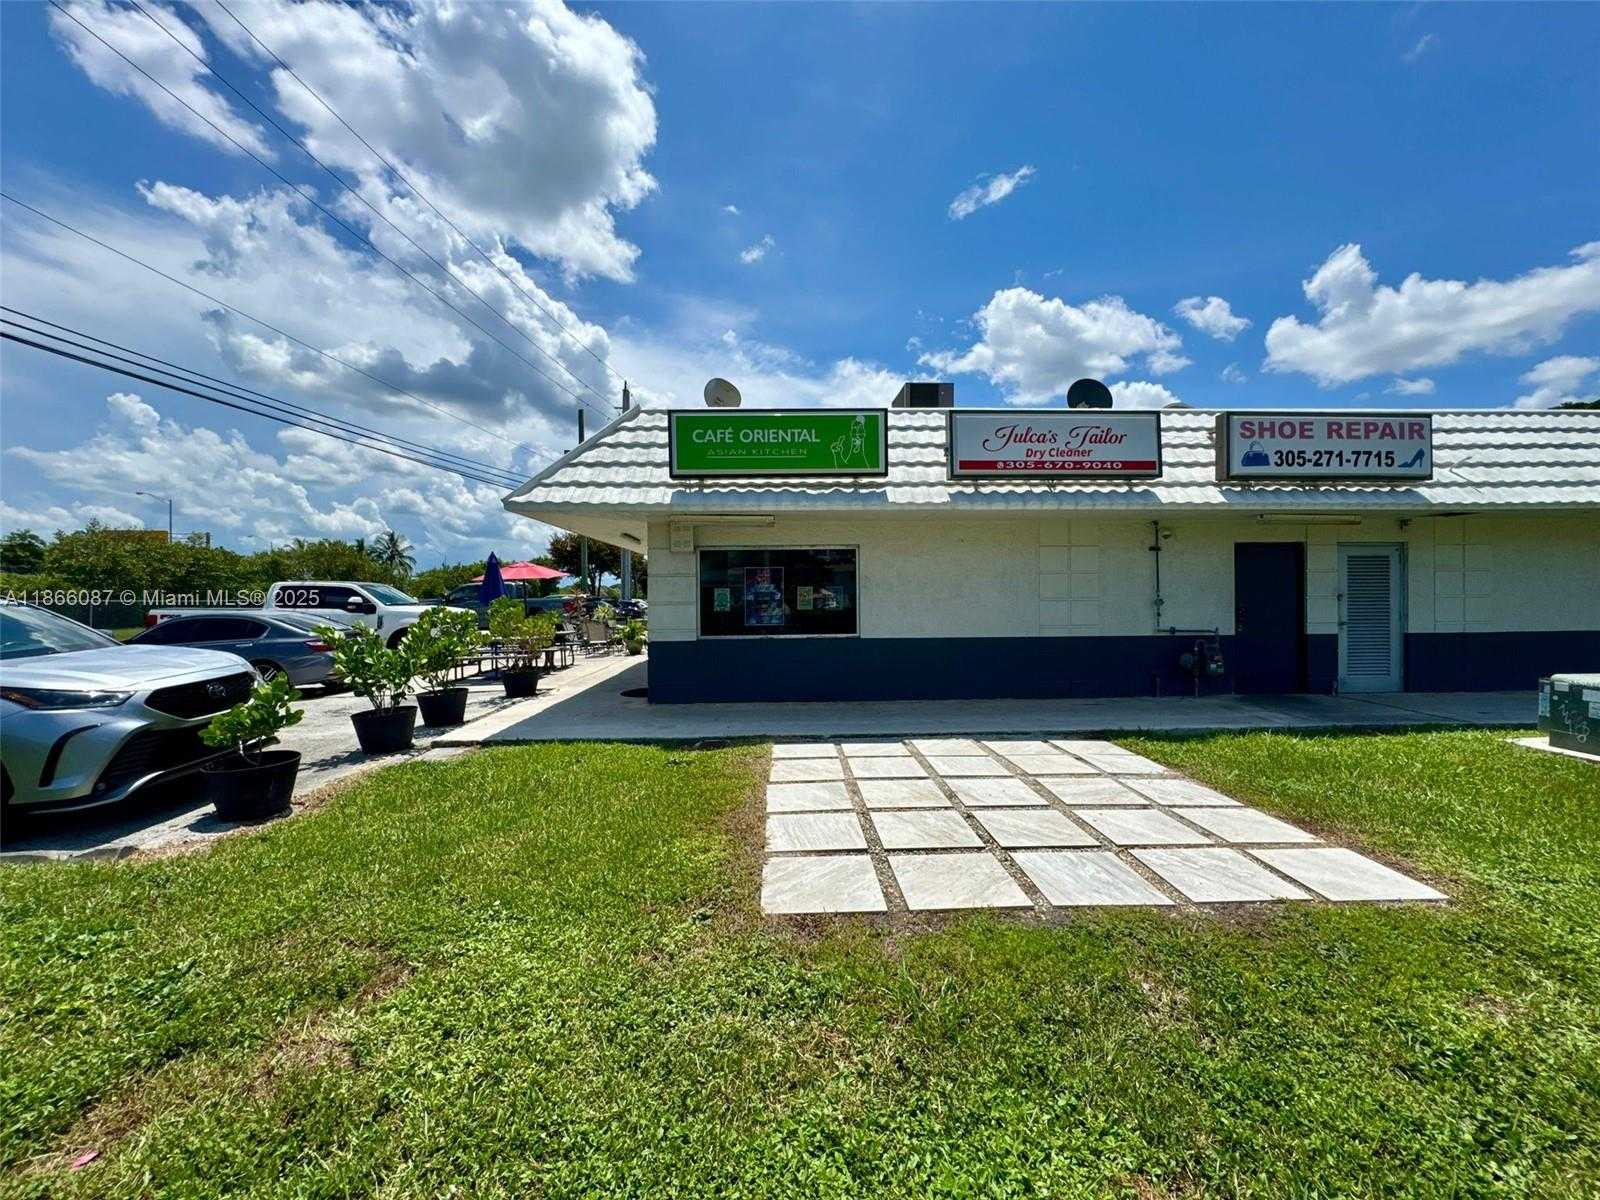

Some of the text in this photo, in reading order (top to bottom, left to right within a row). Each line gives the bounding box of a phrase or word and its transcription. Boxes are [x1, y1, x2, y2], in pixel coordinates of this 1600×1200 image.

[692, 426, 820, 443] CAFÉ ORIENTAL
[982, 424, 1127, 451] Julca's Tailor
[1239, 421, 1425, 440] SHOE REPAIR
[707, 448, 807, 456] ASIAN KITCHEN
[1025, 447, 1093, 460] Dry Cleaner
[1274, 450, 1395, 467] 305-271-7715
[1006, 461, 1122, 469] 305-670-9040
